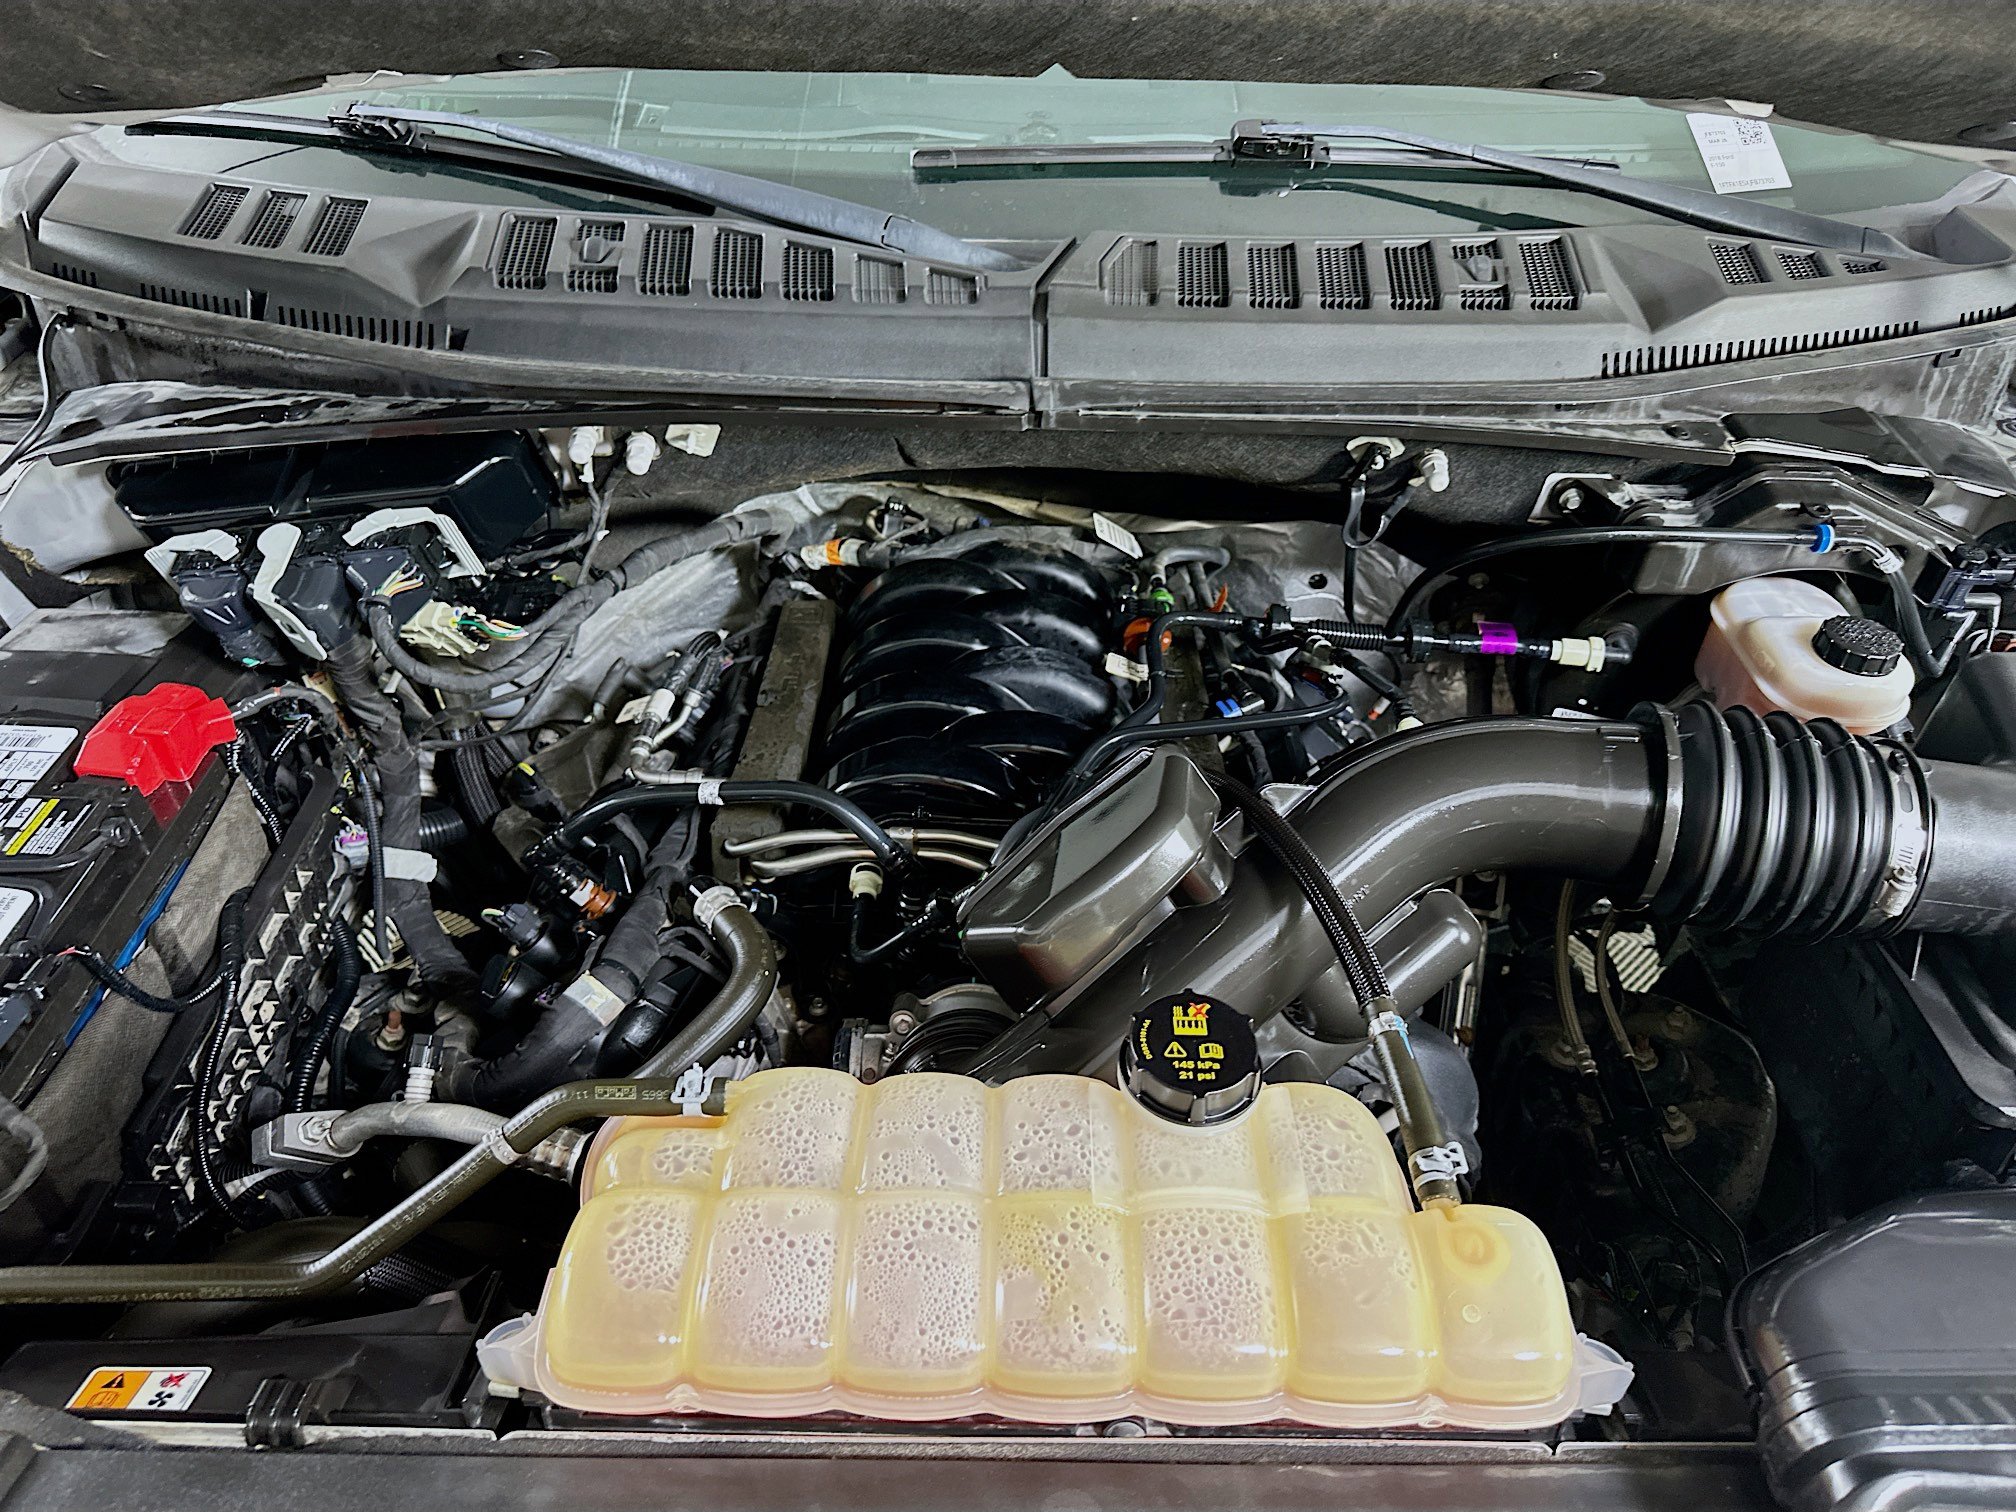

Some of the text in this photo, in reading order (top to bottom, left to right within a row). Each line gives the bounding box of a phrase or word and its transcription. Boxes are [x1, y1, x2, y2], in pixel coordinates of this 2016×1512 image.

[15, 807, 31, 819] Pb
[1172, 1060, 1221, 1069] 145 kPa
[1179, 1070, 1216, 1082] 21 psi
[596, 1087, 636, 1099] FoMoCo
